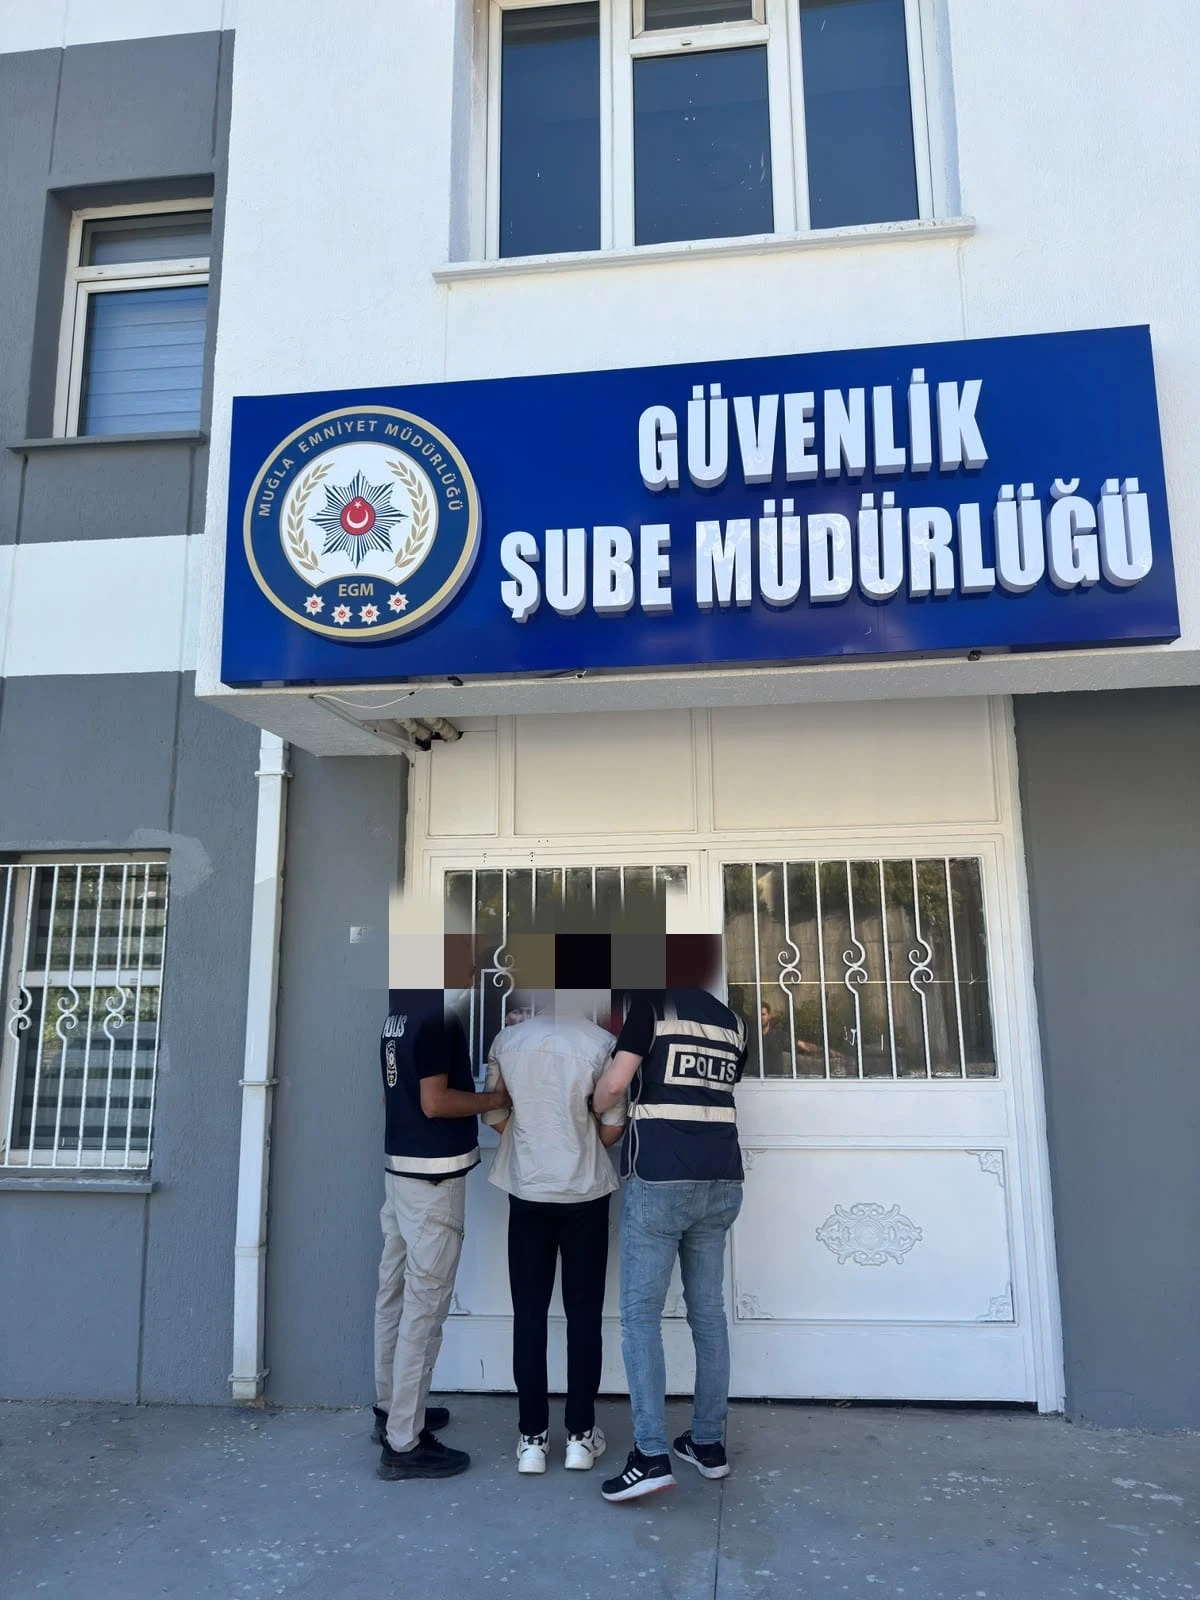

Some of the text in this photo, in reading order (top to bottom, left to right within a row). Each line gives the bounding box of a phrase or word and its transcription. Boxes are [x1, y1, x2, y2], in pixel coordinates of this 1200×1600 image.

[258, 420, 464, 517] MUĞLA EMNİYET MÜDÜRLÜĞÜ
[638, 367, 988, 491] GÜVENLİK
[338, 583, 374, 597] EGM
[500, 477, 1153, 623] ŞUBE MÜDÜRLÜĞÜ
